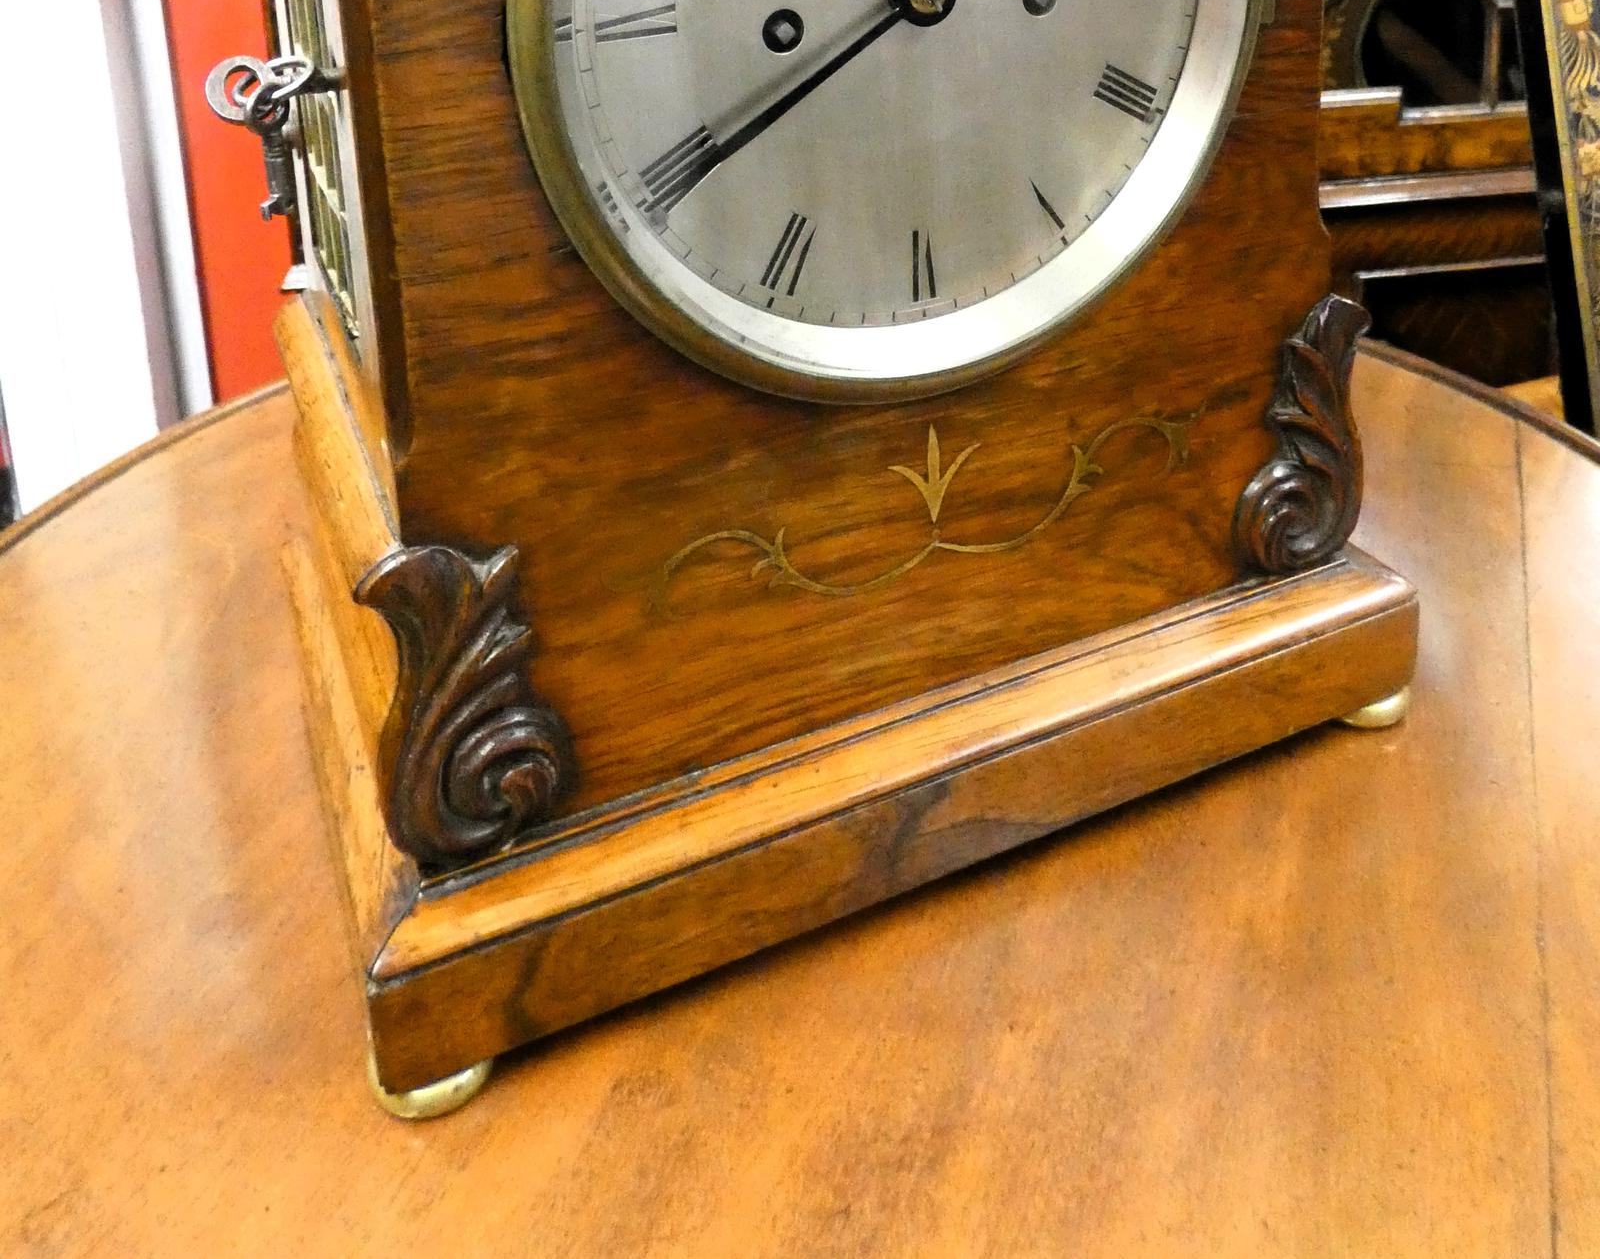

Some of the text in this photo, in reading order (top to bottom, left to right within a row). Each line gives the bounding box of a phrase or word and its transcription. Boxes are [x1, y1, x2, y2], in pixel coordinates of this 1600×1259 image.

[593, 3, 678, 44] IX
[1092, 62, 1159, 123] IIII
[759, 211, 817, 297] VII
[911, 228, 938, 303] VI
